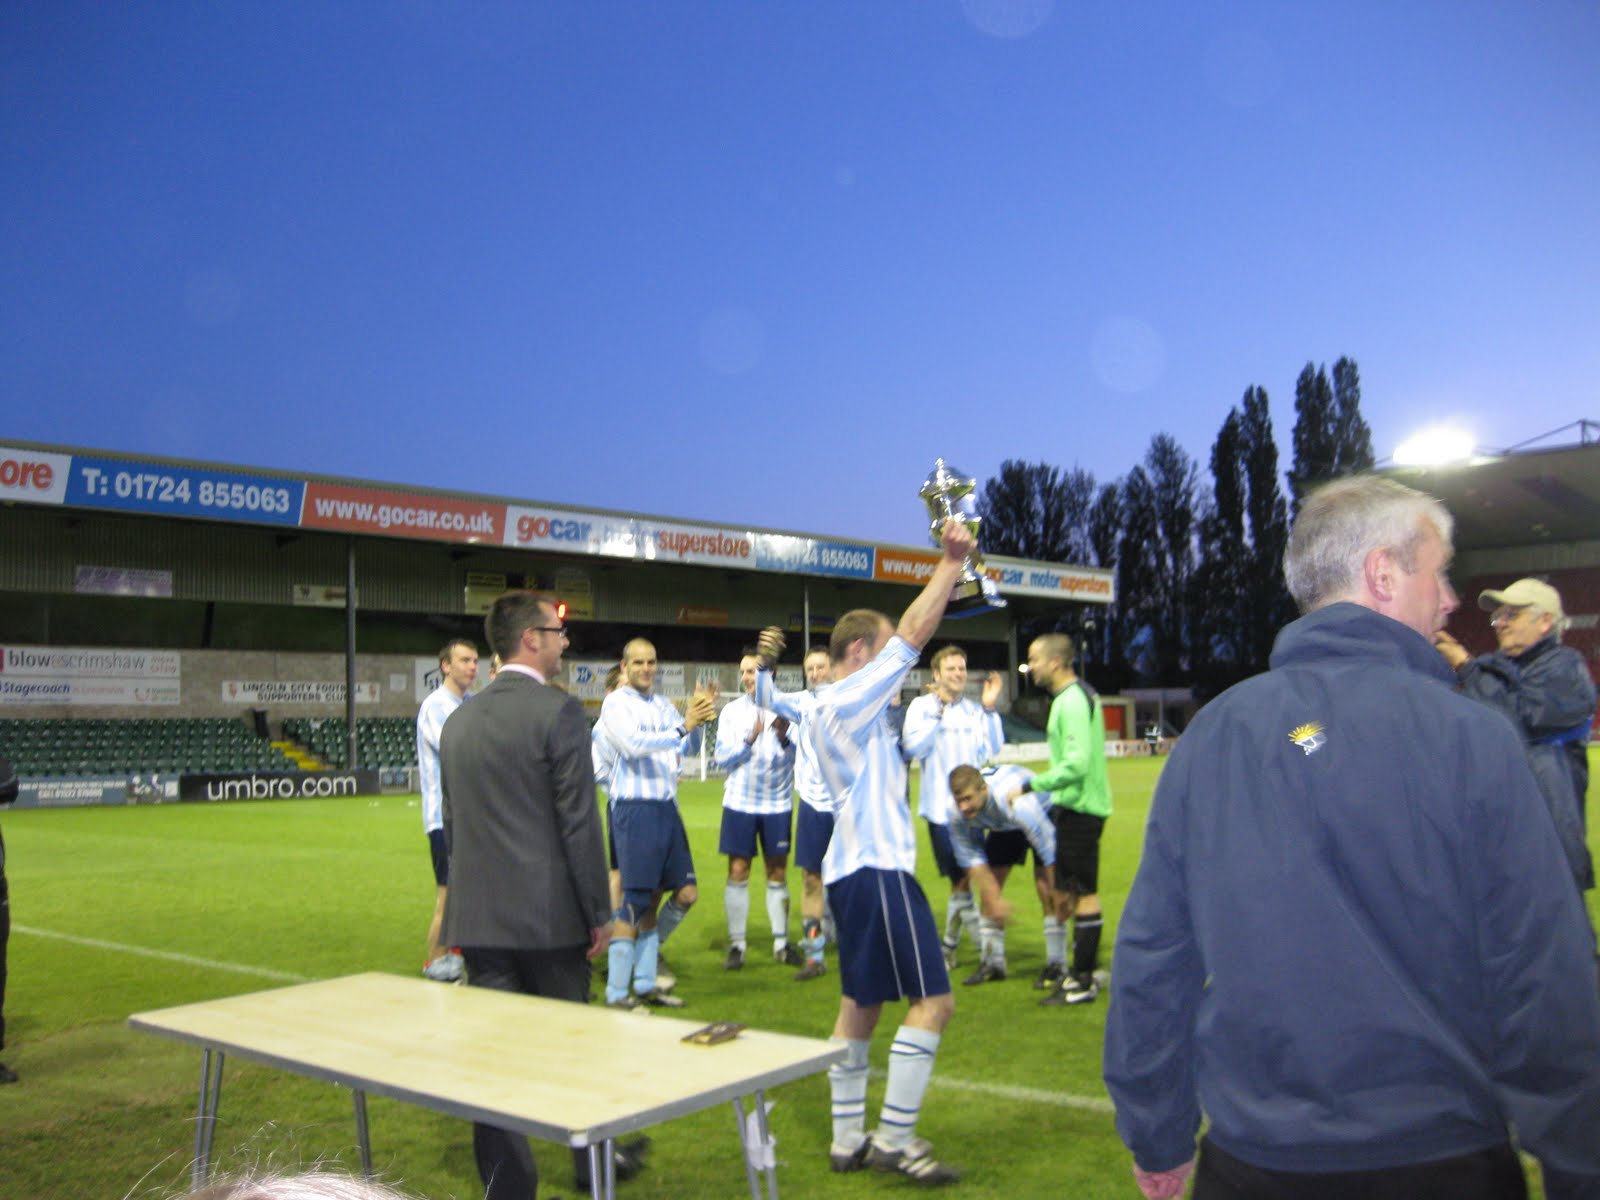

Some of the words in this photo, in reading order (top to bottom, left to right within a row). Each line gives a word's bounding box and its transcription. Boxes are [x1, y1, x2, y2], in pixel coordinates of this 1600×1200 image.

[82, 467, 108, 496] T:
[114, 471, 191, 504] 01724
[198, 480, 290, 514] 855063
[315, 498, 495, 533] www.gocar.co.uk
[516, 514, 591, 543] gocar
[821, 548, 869, 572] 855063
[3, 681, 72, 697] Stagecoach
[242, 682, 287, 693] LINCOLN
[290, 682, 313, 693] CITY
[257, 692, 322, 702] SUPPORTERS
[207, 775, 357, 801] umbro.com
